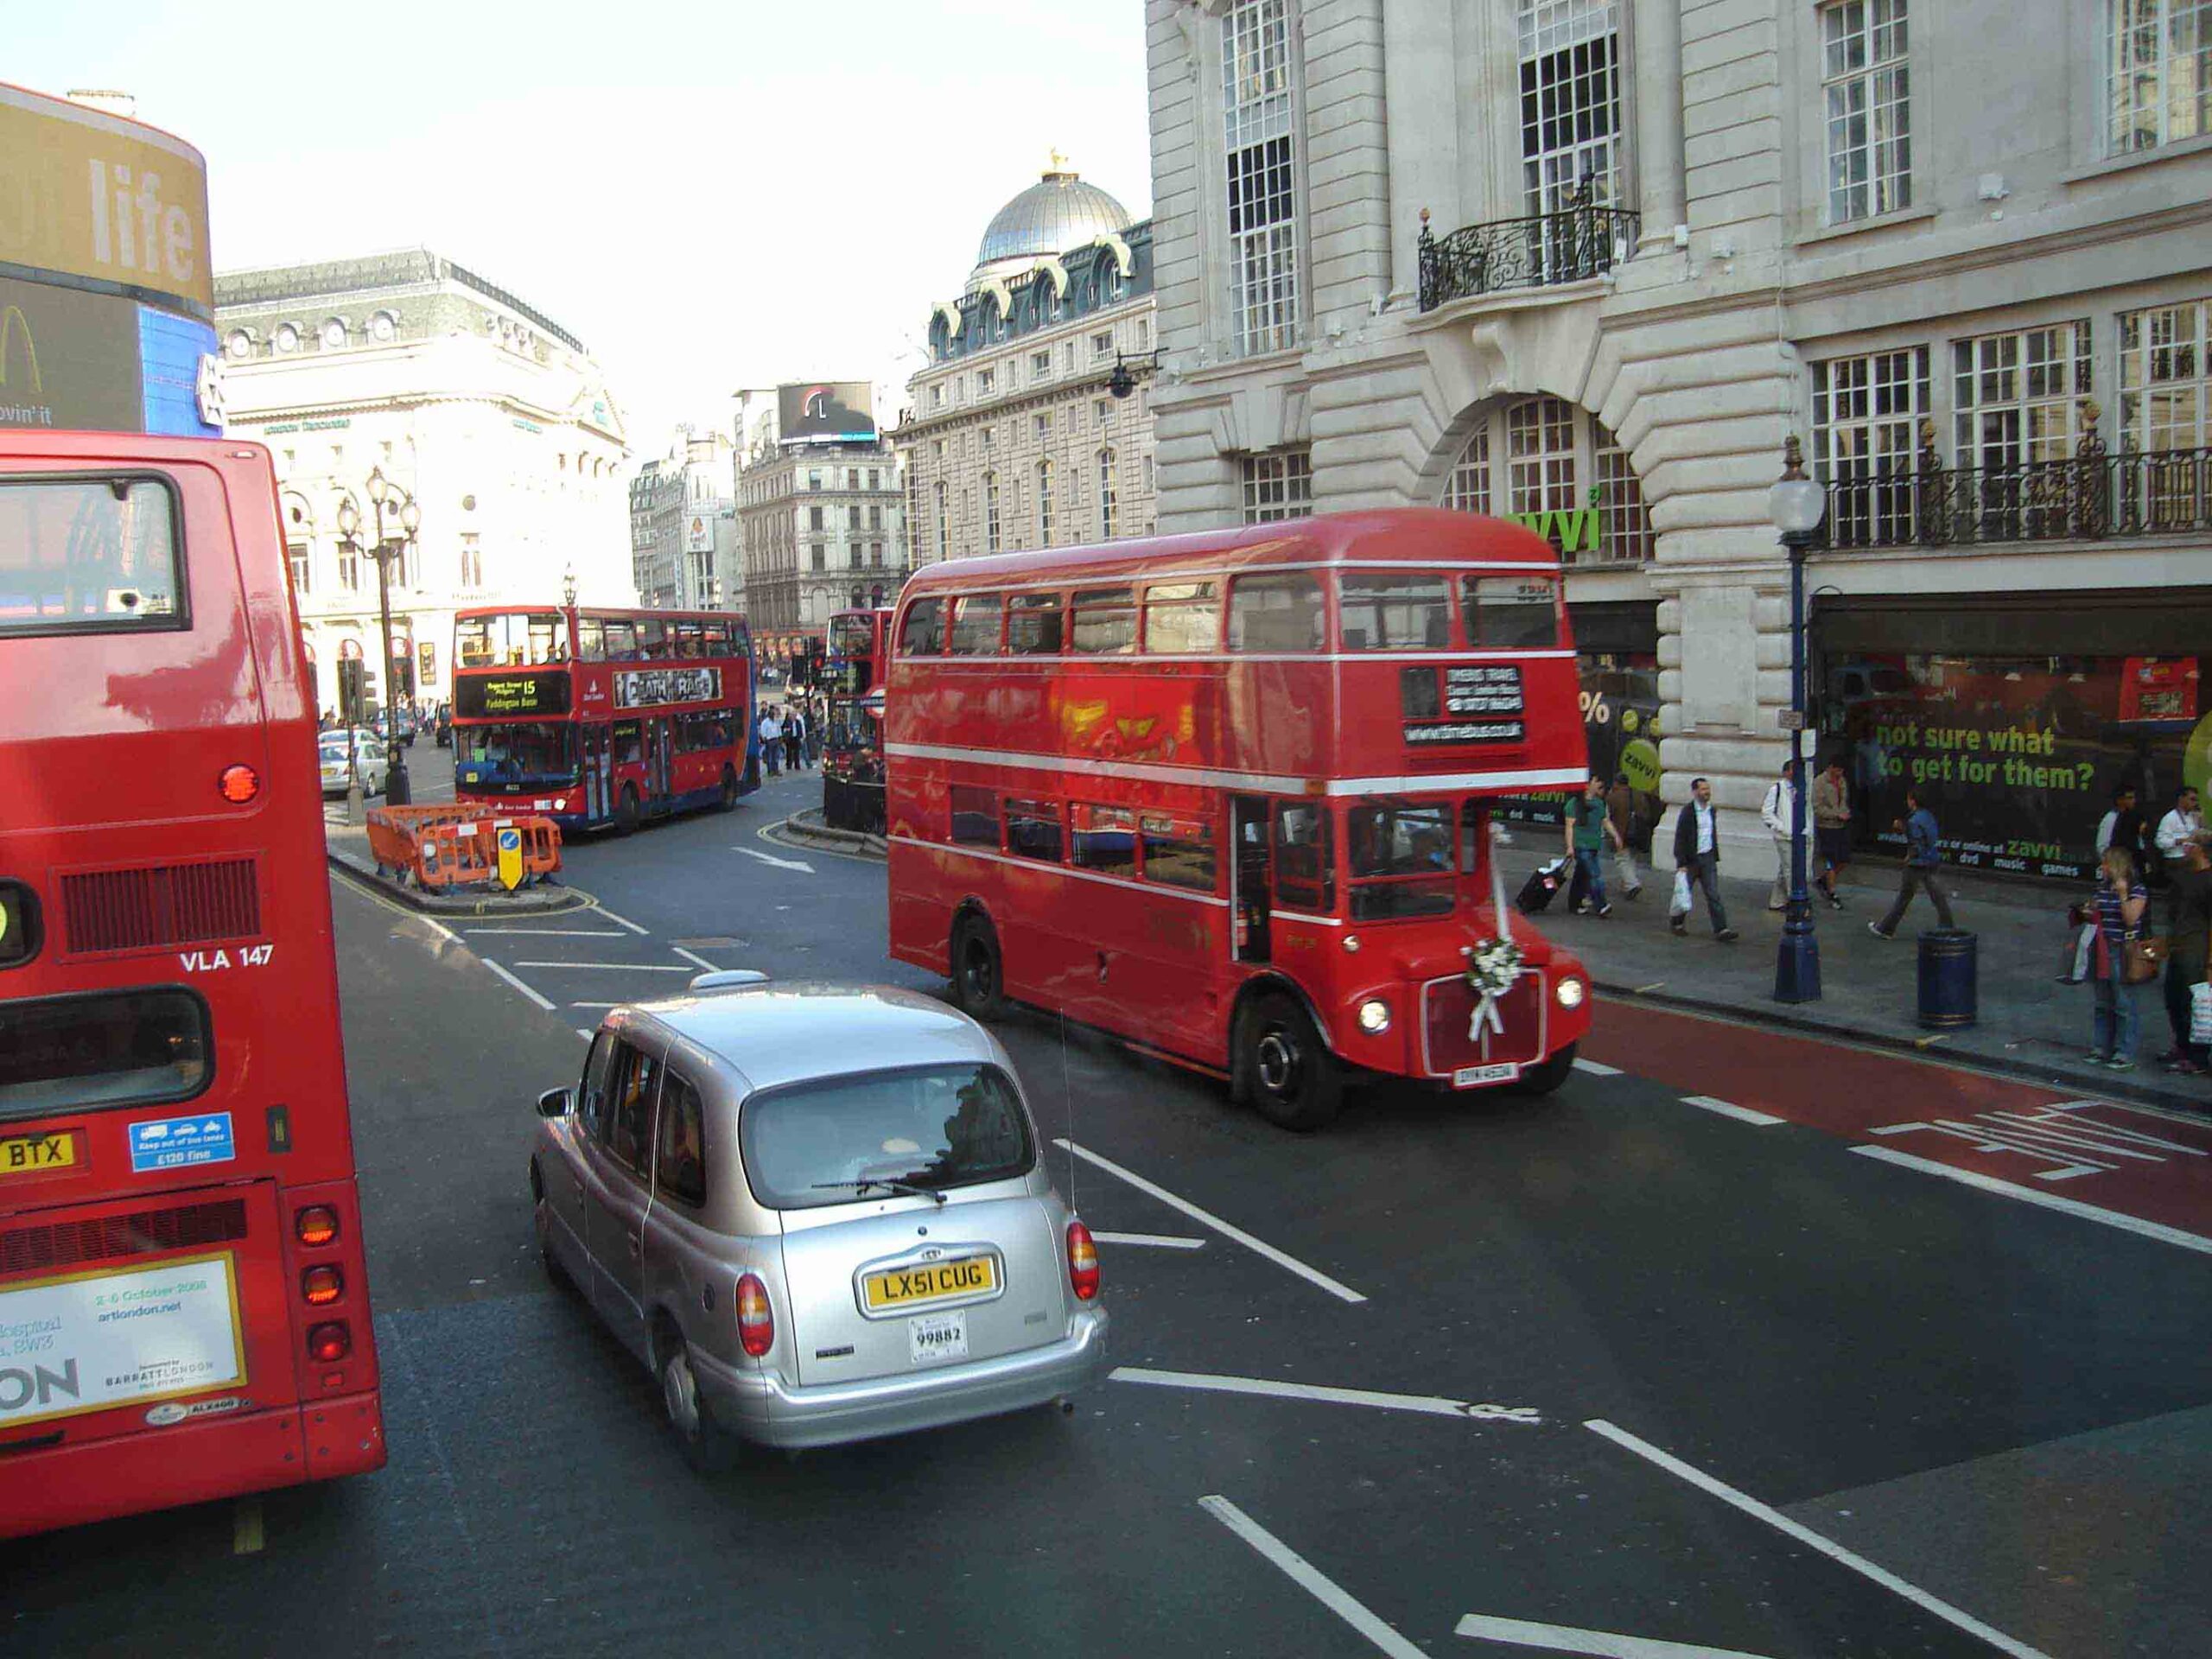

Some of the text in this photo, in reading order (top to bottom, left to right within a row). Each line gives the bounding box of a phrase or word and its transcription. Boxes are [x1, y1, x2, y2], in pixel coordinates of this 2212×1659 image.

[89, 159, 193, 281] life
[524, 681, 536, 695] 15
[1876, 721, 2055, 755] not sure what
[1624, 752, 1656, 778] zavvi
[1878, 750, 2095, 791] to get for them?
[2006, 837, 2063, 861] zavvi
[1959, 851, 1980, 865] dvd
[1993, 857, 2026, 871] music
[2040, 861, 2078, 878] games
[180, 944, 274, 972] VLA 147
[9, 1139, 62, 1166] BTX
[187, 1149, 212, 1161] fine
[123, 1286, 173, 1302] October
[883, 1264, 982, 1299] LX51 CUG
[98, 1300, 181, 1323] artlondon.net
[917, 1327, 960, 1347] 99882
